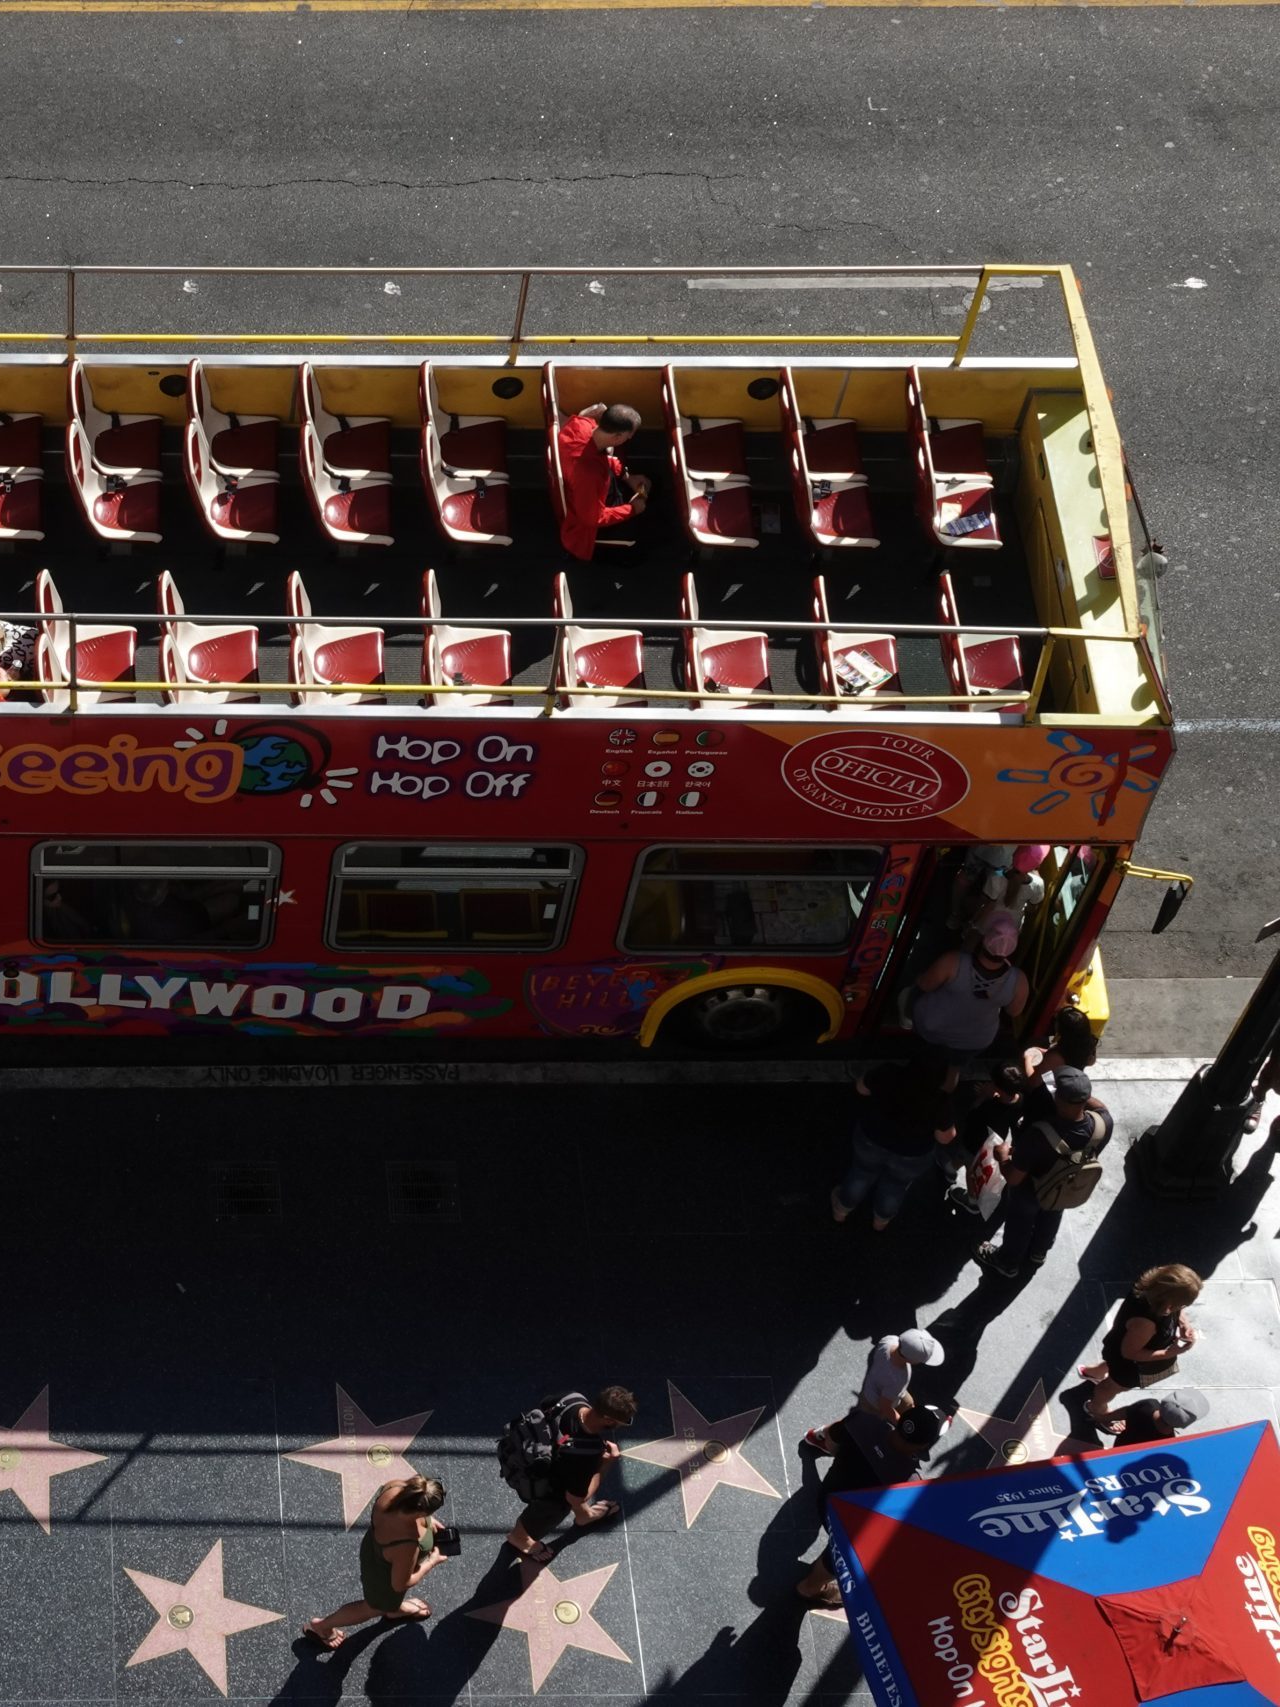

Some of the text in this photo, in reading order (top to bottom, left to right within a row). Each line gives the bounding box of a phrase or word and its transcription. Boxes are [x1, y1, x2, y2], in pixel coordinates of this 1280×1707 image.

[376, 735, 534, 765] Hop On
[881, 736, 936, 761] TOUR
[370, 771, 532, 800] Hop Off
[602, 779, 623, 787] 中文
[637, 780, 671, 788] 日本語
[821, 755, 933, 797] OFFICIAL
[792, 768, 933, 817] OF SANTA MONICA
[206, 1065, 460, 1082] PASSENGER LOADING ONLY
[684, 1426, 702, 1481] BEE GEES
[995, 1484, 1063, 1503] Since 1935
[1083, 1464, 1180, 1495] TOURS
[968, 1478, 1211, 1543] StarLine
